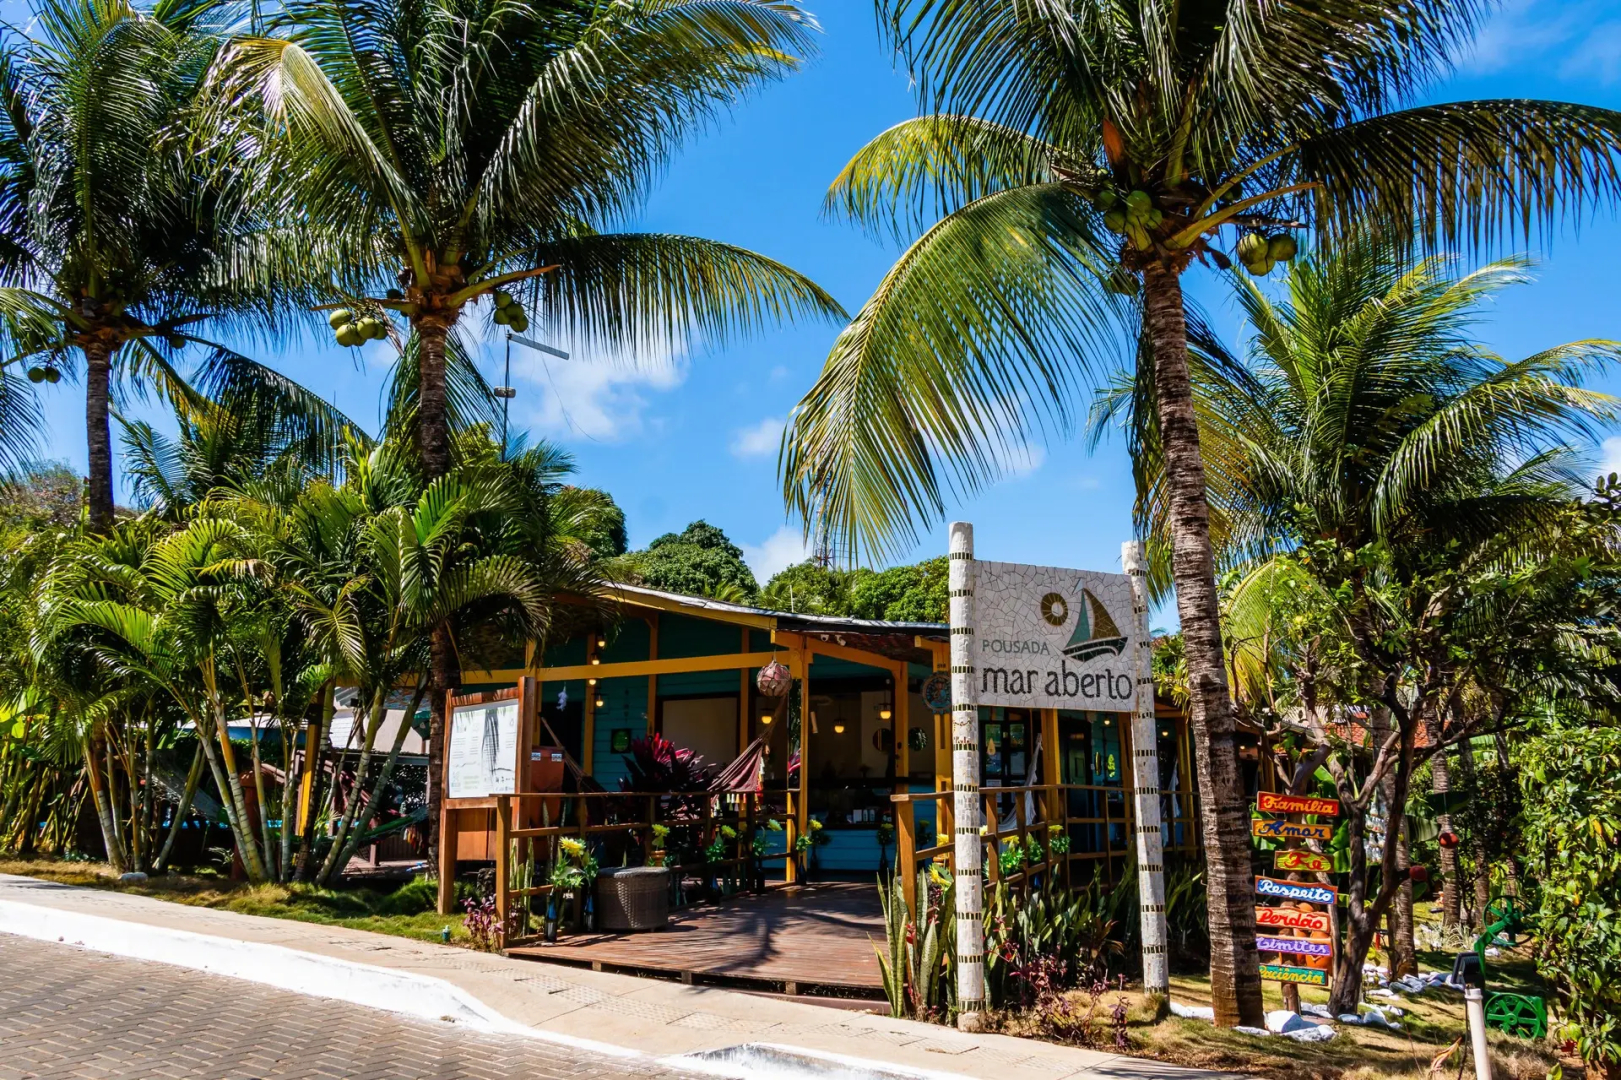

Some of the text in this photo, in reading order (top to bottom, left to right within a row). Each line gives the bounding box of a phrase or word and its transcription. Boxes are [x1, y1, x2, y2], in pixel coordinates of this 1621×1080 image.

[982, 639, 1050, 655] POUSADA
[981, 659, 1133, 700] mar aberto
[1263, 795, 1334, 813] Família
[1258, 821, 1325, 838] Amor
[1284, 850, 1325, 870] Fé
[1258, 879, 1332, 901] Respeito
[1256, 908, 1323, 929] Perdão
[1256, 936, 1327, 953] Limites
